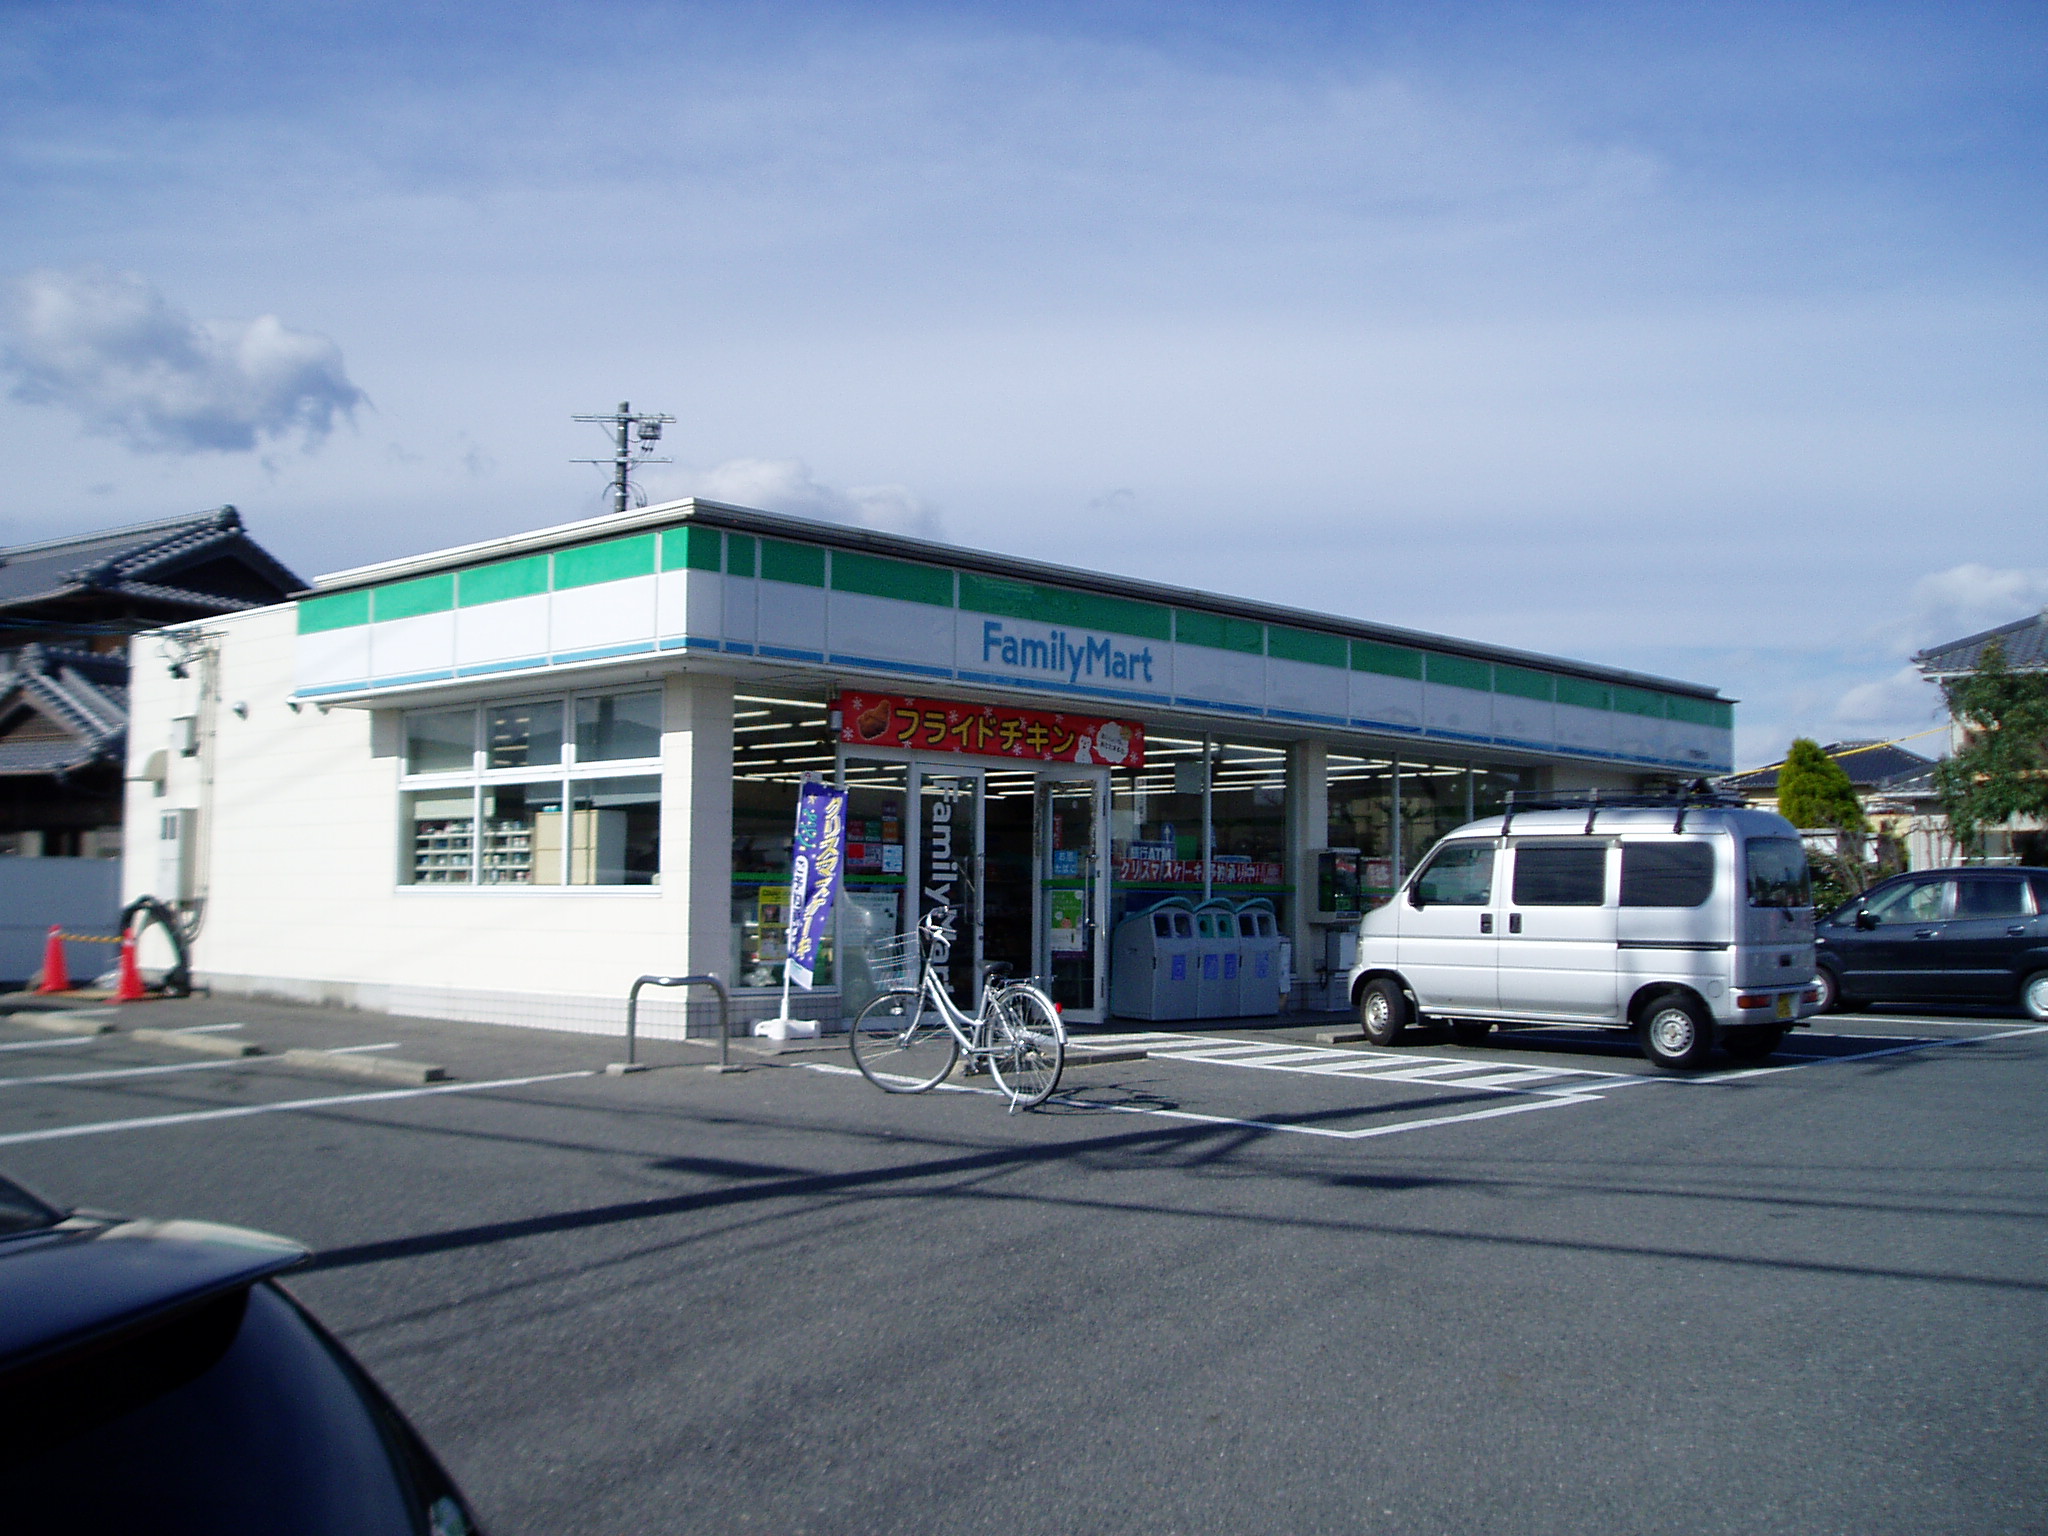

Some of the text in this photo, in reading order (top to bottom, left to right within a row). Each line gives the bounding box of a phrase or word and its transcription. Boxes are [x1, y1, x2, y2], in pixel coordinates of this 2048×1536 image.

[983, 621, 1152, 683] FamilyMart
[895, 709, 1075, 754] フライドチキン
